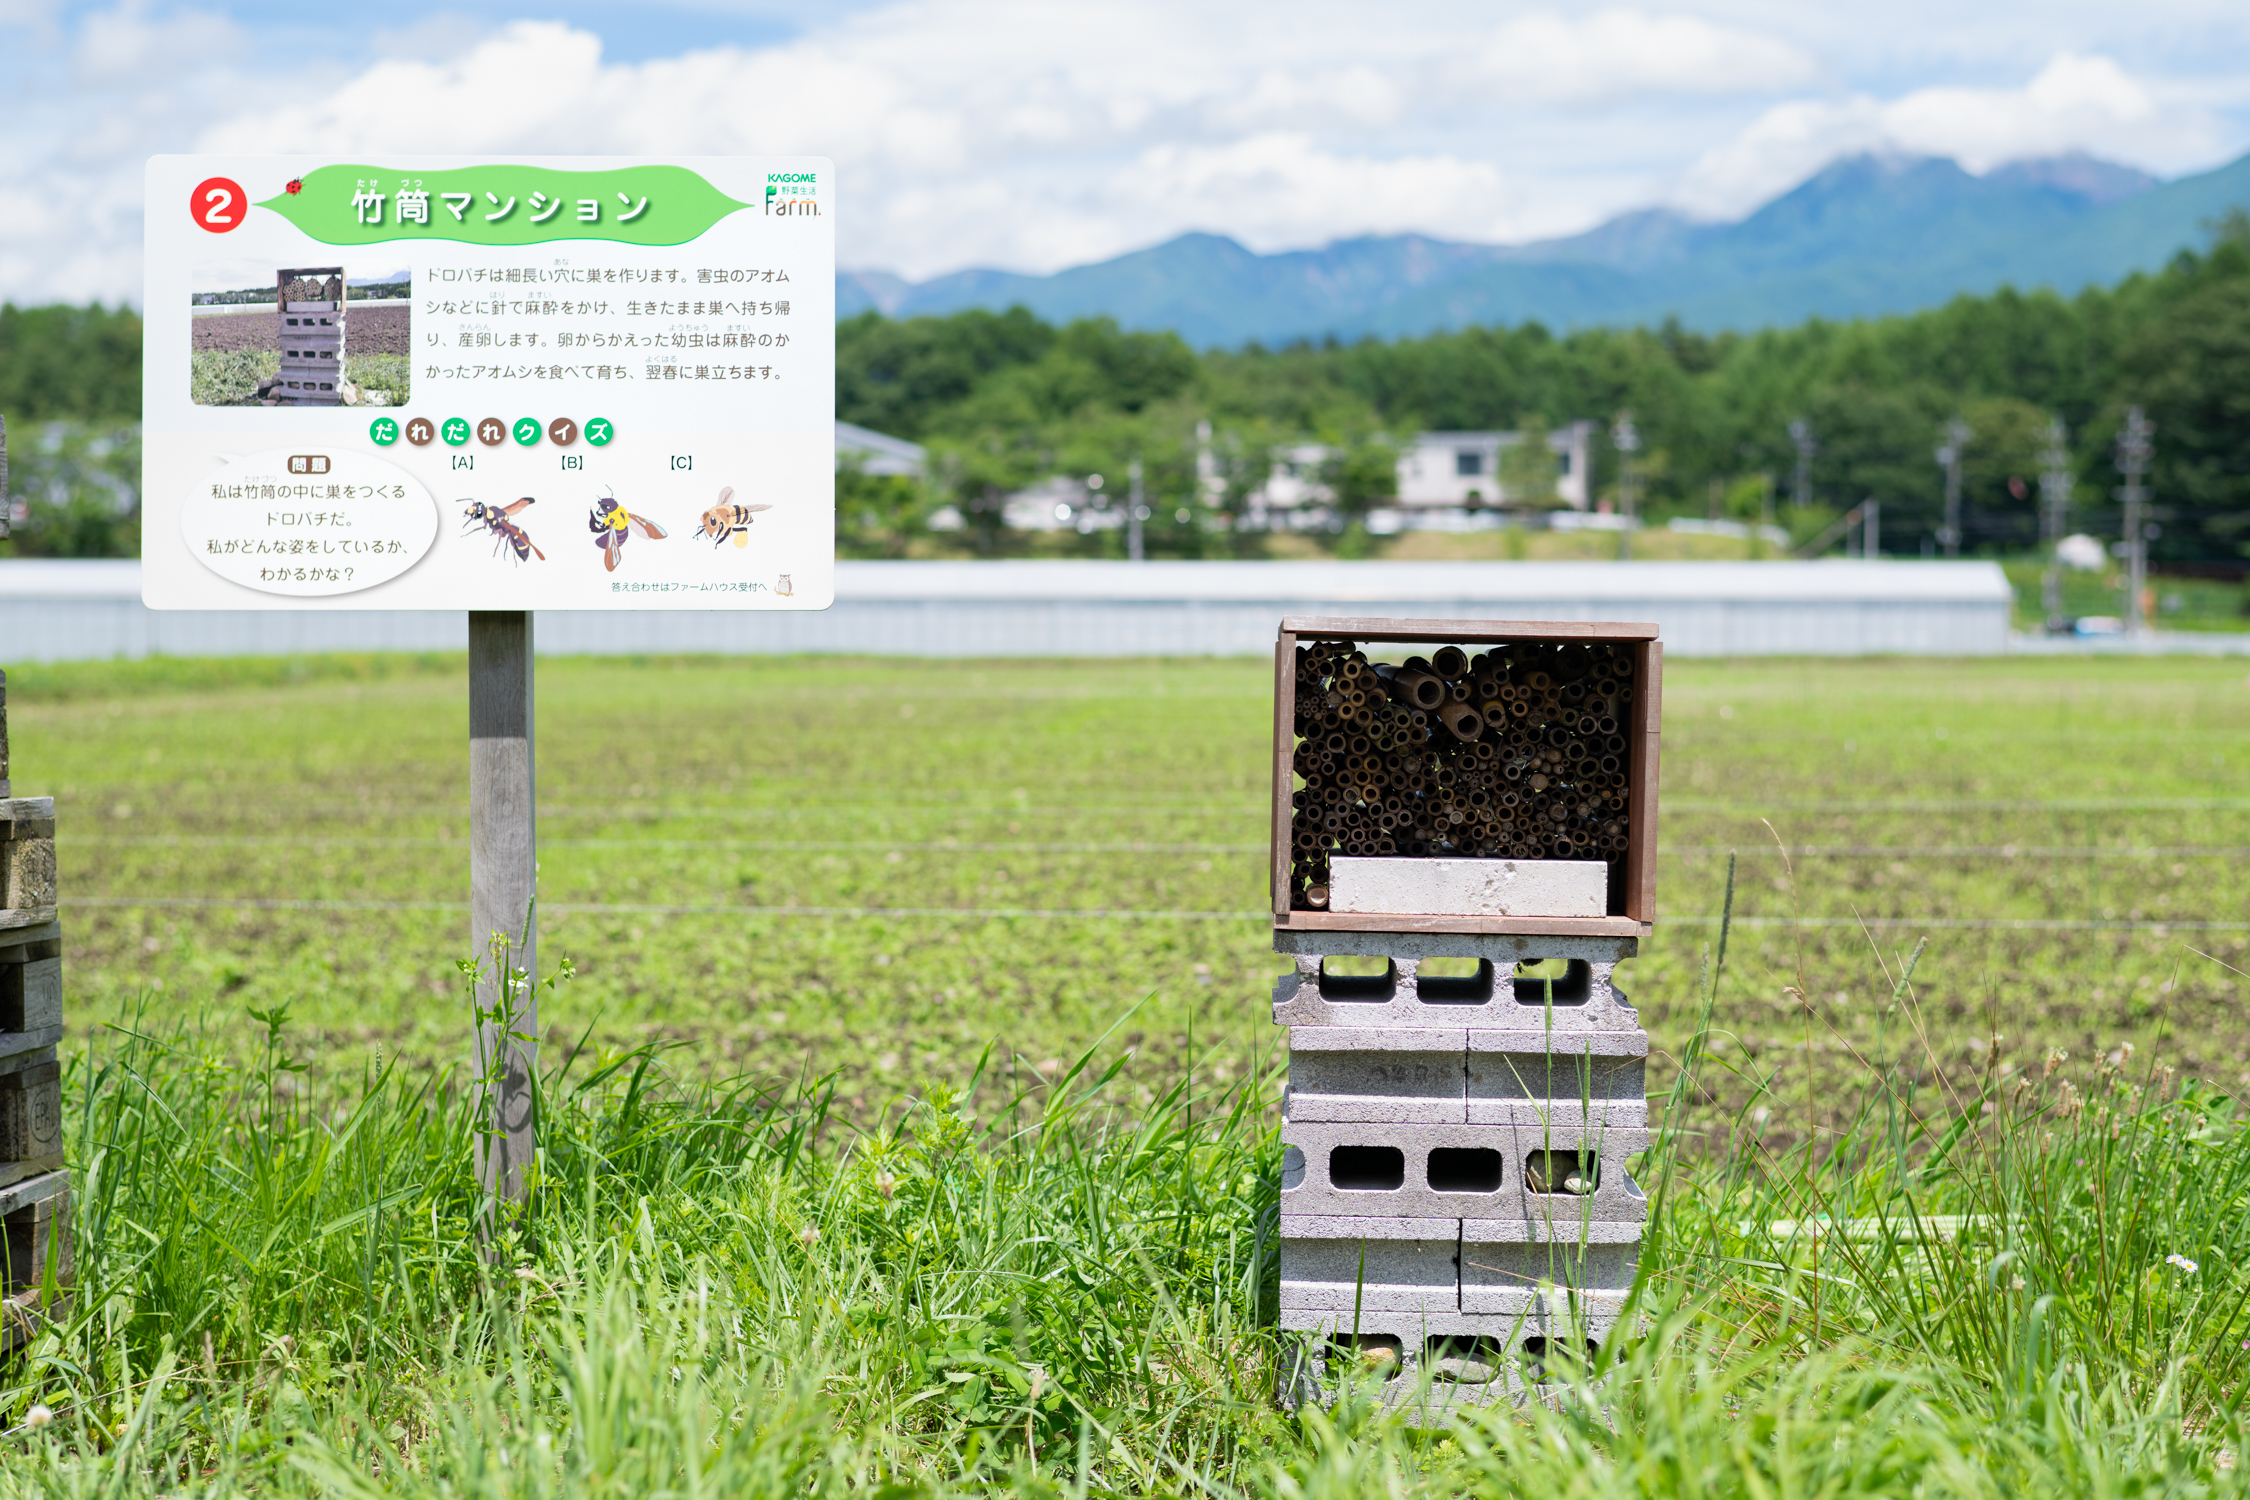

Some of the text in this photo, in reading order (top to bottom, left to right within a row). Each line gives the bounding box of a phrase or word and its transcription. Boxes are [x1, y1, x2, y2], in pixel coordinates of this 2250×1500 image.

[358, 179, 378, 187] たけ
[768, 174, 816, 183] KAGOME
[782, 186, 816, 195] 野菜生活
[205, 187, 233, 223] 2
[351, 189, 646, 223] 竹筒マンション
[427, 300, 790, 315] シなどに針で麻酔をかけ、生きたまま巣へ持ち帰
[428, 331, 789, 348] り、産卵します。卵からかえった幼虫は麻酔のか
[426, 365, 780, 380] かったアオムシを食べて育ち、翌春に巣立ちます。
[375, 423, 607, 440] だれだれクイズ
[212, 484, 405, 499] 私は竹筒の中に巣をつくる
[207, 539, 407, 554] 私がどんな姿をしているか、
[612, 582, 767, 592] 答え合わせはファームハウス受付へ
